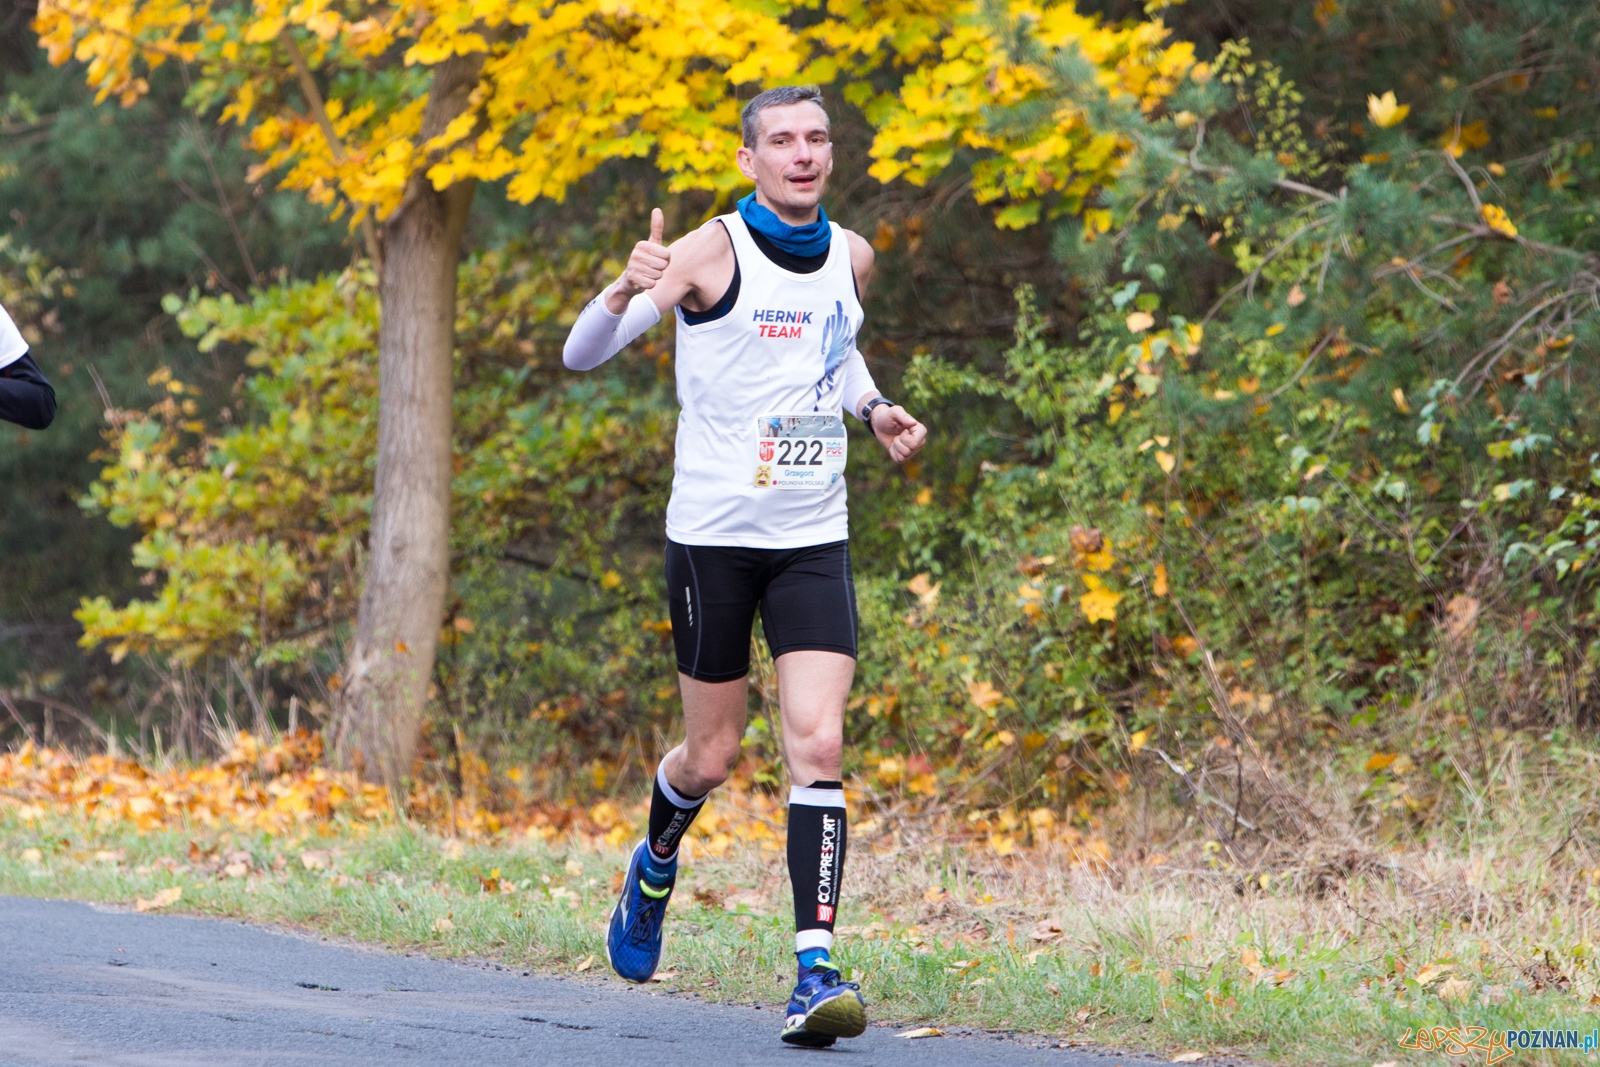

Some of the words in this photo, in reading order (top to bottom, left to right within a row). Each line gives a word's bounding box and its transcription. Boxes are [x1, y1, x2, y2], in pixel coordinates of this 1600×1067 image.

[753, 309, 813, 324] HERNIK
[758, 325, 802, 338] TEAM
[777, 440, 823, 465] 222
[784, 469, 815, 478] Grzegorz
